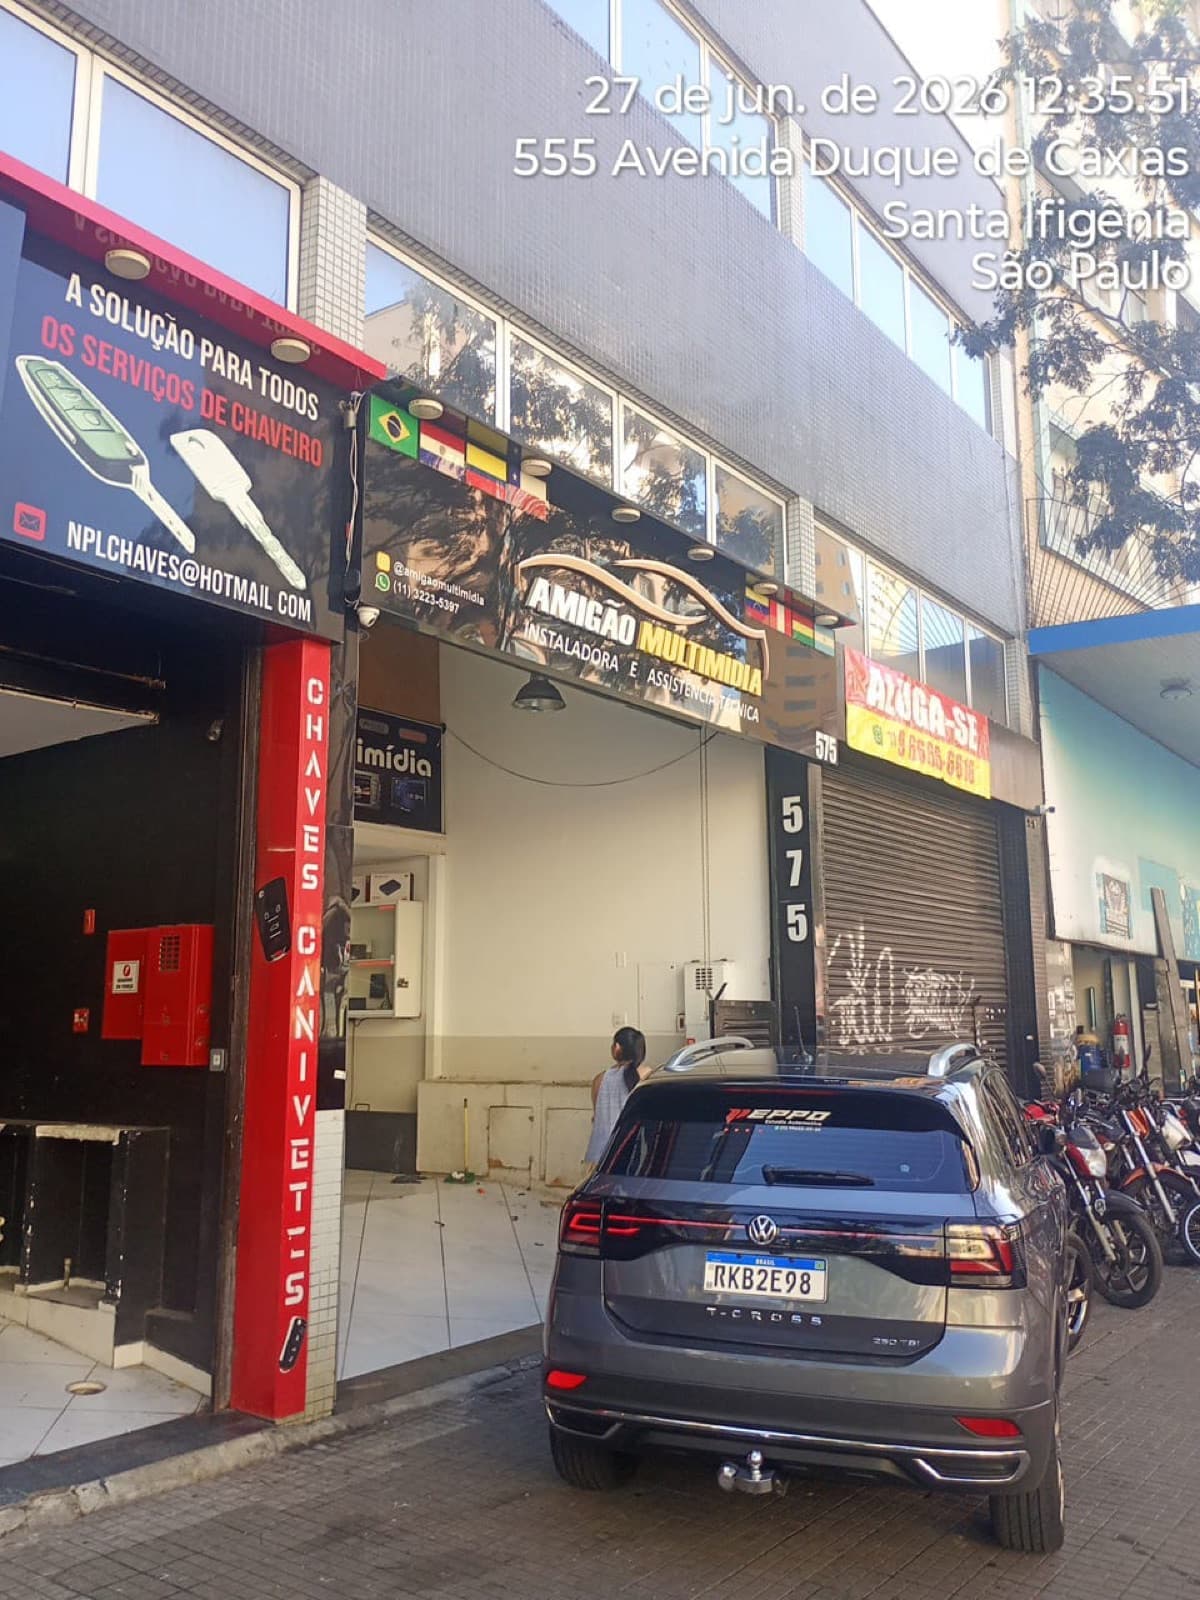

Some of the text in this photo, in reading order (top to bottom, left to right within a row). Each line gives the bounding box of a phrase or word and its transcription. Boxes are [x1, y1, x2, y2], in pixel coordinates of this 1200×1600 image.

[65, 273, 82, 307] A
[90, 284, 195, 360] SOLUÇÃO
[200, 337, 253, 390] PARA
[259, 366, 319, 421] TODOS
[41, 315, 322, 467] OS SERVIÇOS DE CHAVEIRO
[67, 521, 311, 622] NPLCHAVES@HOTMAIL COM
[393, 580, 411, 599] (11)
[524, 620, 619, 672] INSTALADORA
[630, 662, 639, 678] E
[525, 577, 762, 697] AMIGÃO MULTIMÍDIA
[815, 730, 837, 765] 575
[866, 665, 978, 751] ALUGA-SE
[301, 677, 324, 890] CHAVES
[782, 796, 808, 942] 575
[714, 1265, 811, 1295] RKB2E98
[755, 1257, 776, 1267] BRASIL
[706, 1307, 822, 1326] T-CROSS
